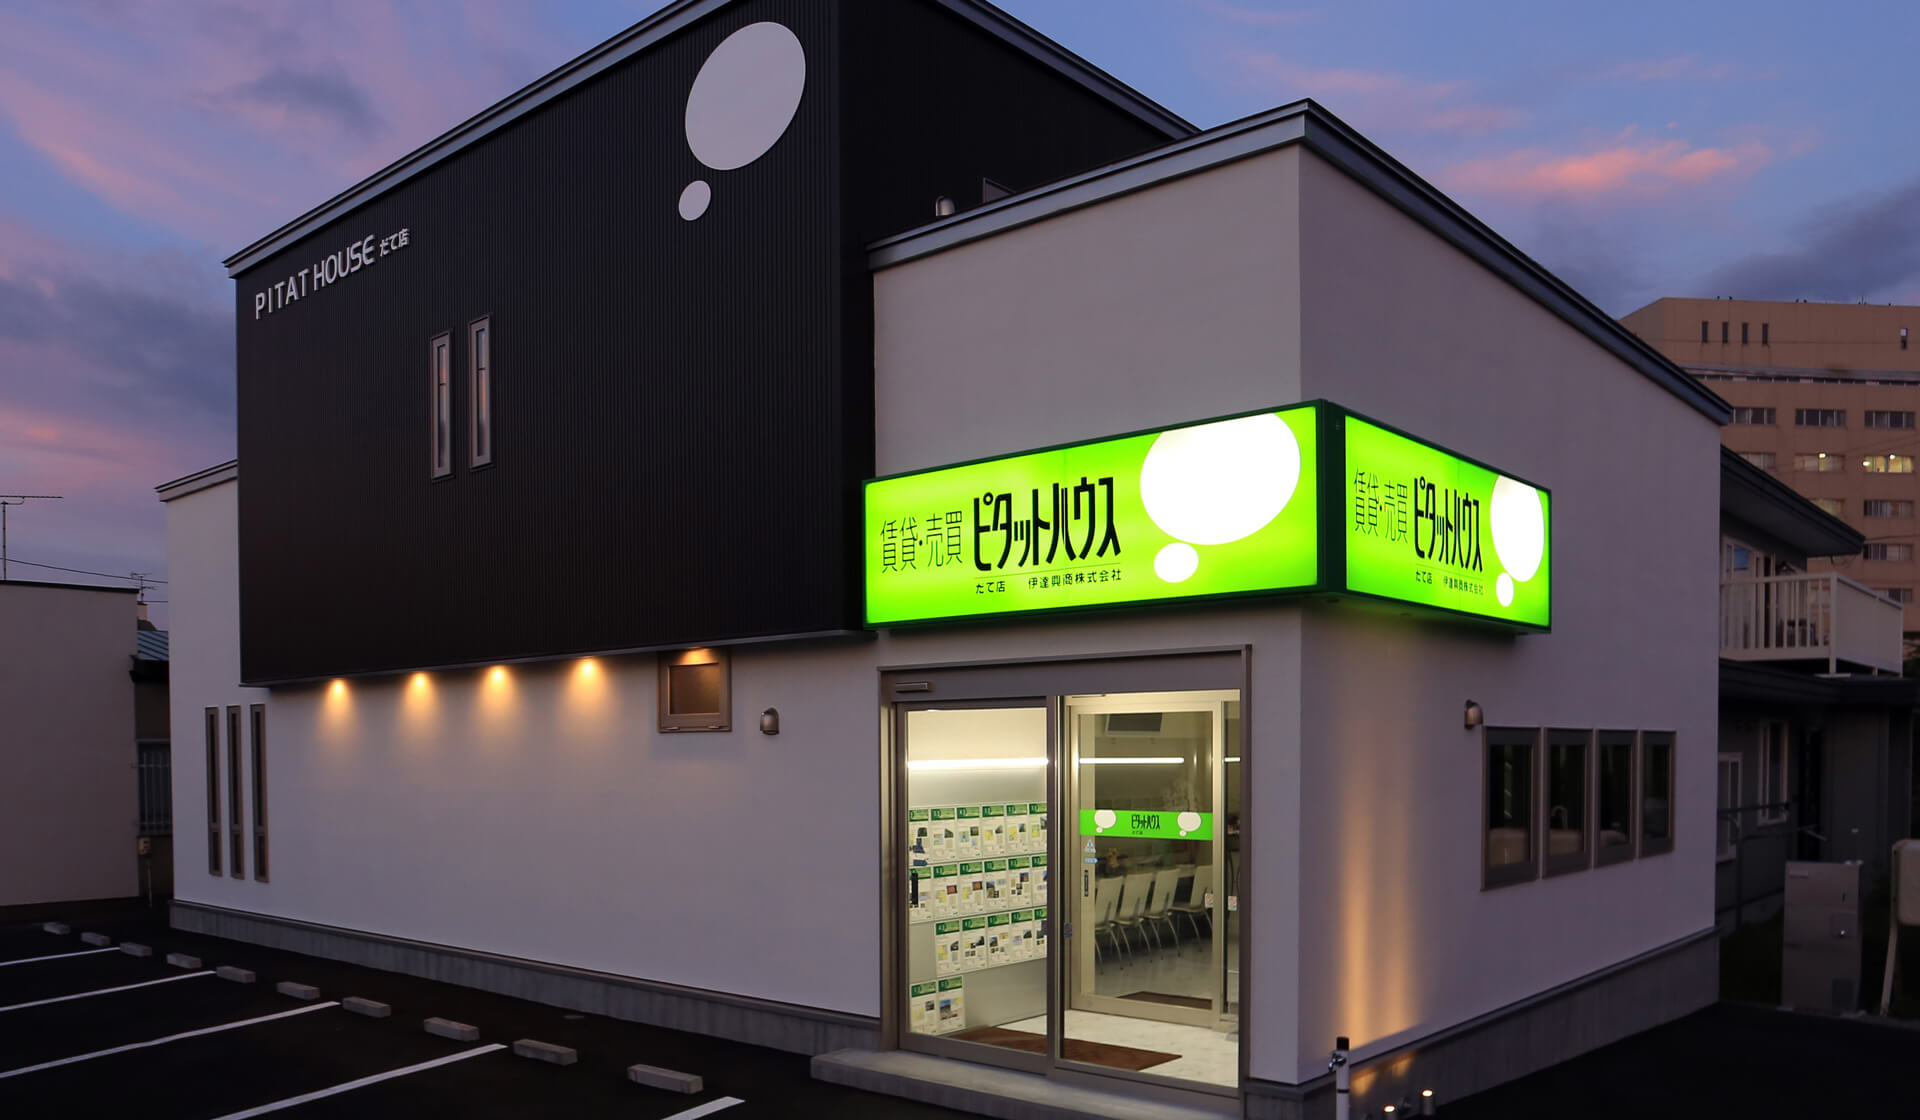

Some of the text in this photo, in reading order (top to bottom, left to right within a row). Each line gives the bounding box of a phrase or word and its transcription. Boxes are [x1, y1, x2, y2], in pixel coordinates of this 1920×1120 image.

[255, 228, 410, 320] PITAT HOUSE だて店
[973, 476, 1121, 571] ピタットハウス
[1413, 476, 1483, 572] ピタットハウス
